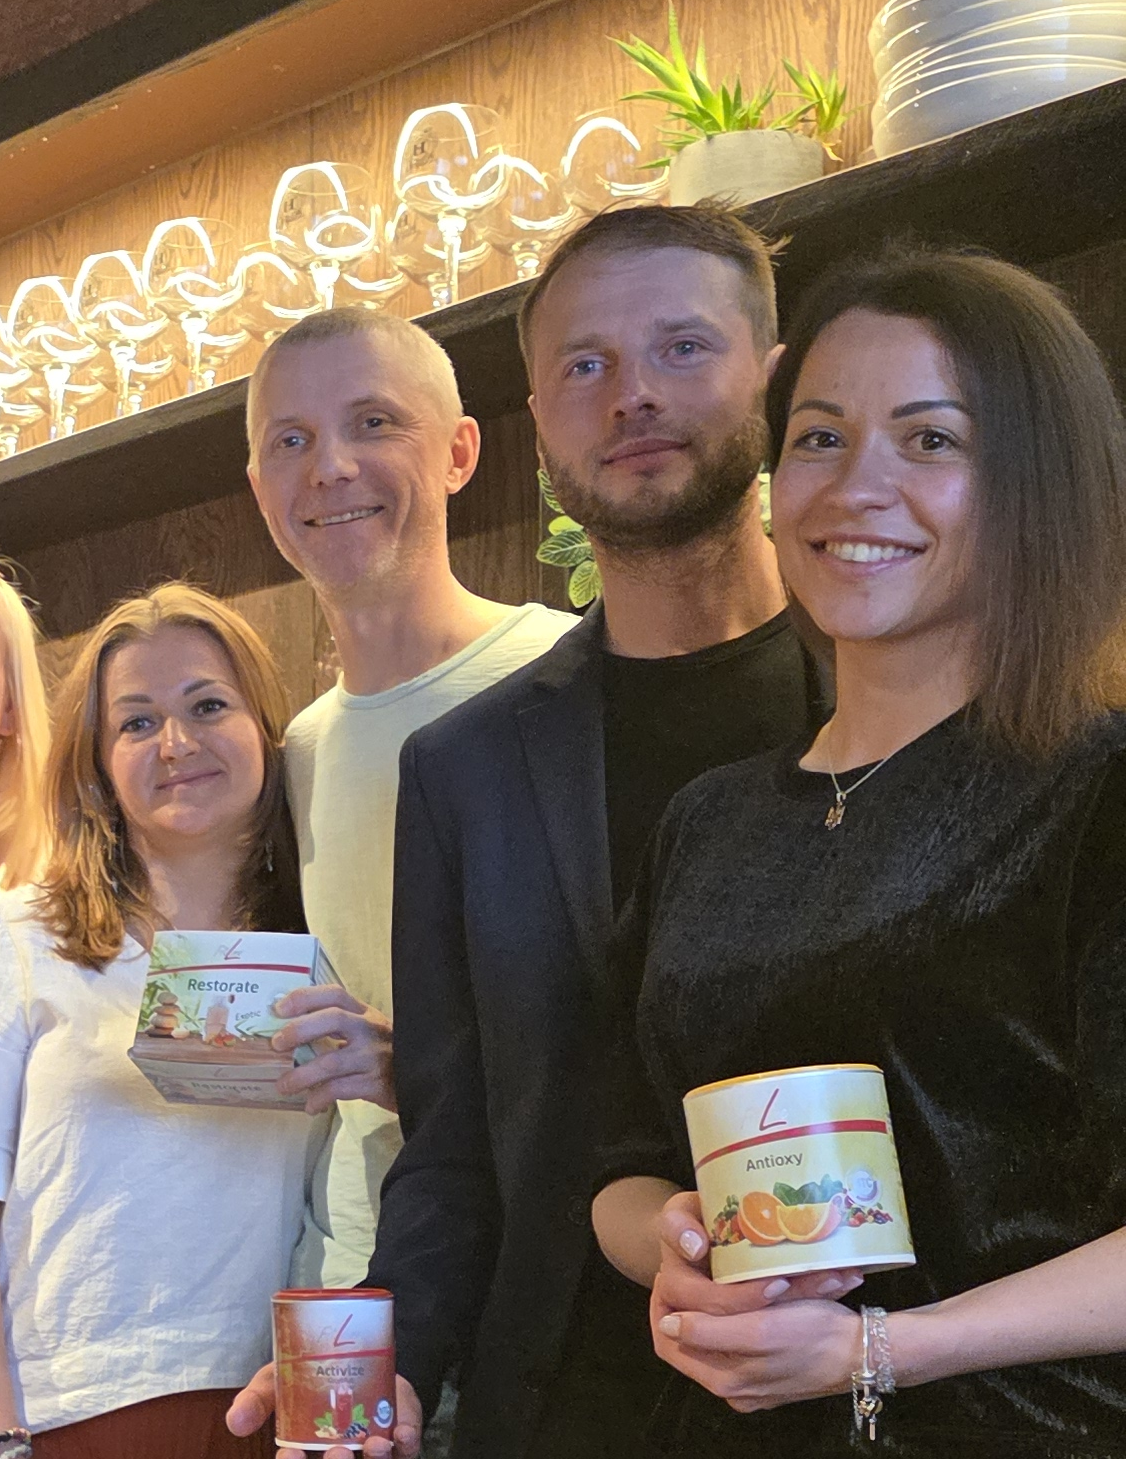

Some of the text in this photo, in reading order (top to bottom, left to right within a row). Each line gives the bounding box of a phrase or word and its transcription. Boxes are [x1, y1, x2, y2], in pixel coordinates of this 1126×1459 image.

[187, 978, 259, 994] Restorate
[745, 1152, 803, 1173] Antioxy
[316, 1365, 365, 1377] Activize
